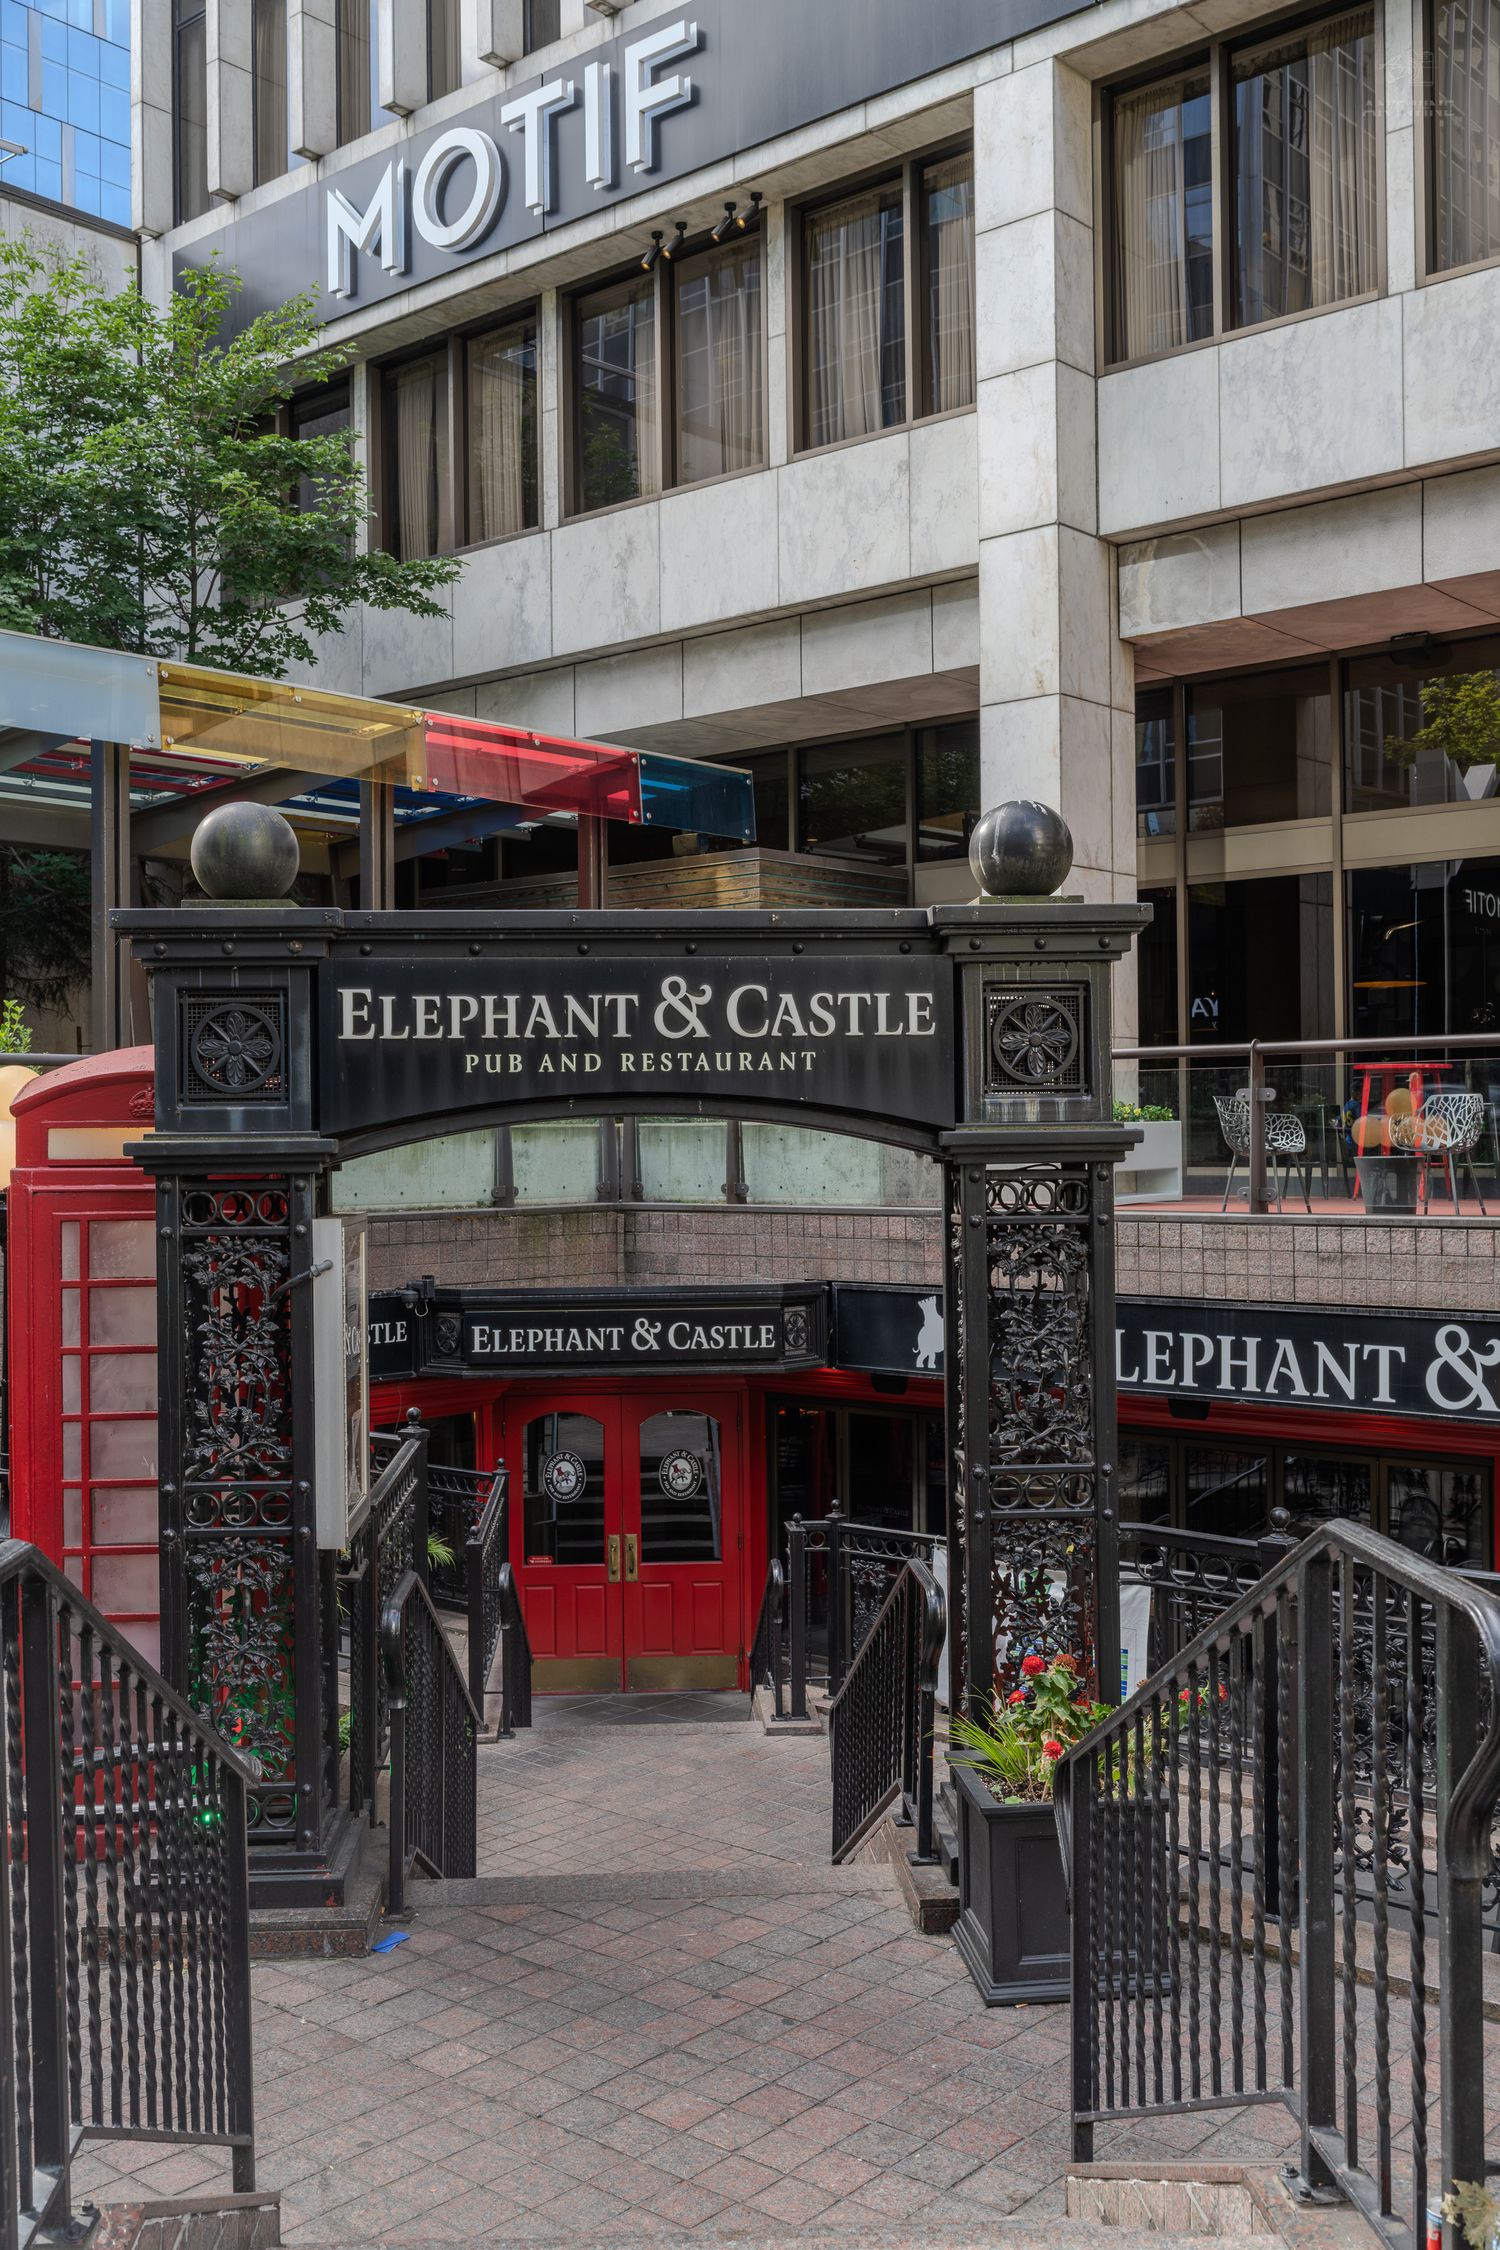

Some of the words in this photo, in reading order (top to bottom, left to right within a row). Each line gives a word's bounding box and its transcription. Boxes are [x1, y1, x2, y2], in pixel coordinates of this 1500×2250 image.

[327, 20, 697, 299] MOTIF
[337, 988, 638, 1040] ELEPHANT
[654, 975, 712, 1039] &
[727, 985, 936, 1037] CASTLE
[465, 1053, 523, 1074] PUB
[538, 1052, 601, 1072] AND
[621, 1051, 817, 1072] RESTAURANT
[471, 1326, 624, 1353] ELEPHANT
[631, 1318, 662, 1351] &
[668, 1322, 775, 1350] CASTLE
[1116, 1329, 1405, 1403] LEPHANT
[1426, 1324, 1500, 1412] &
